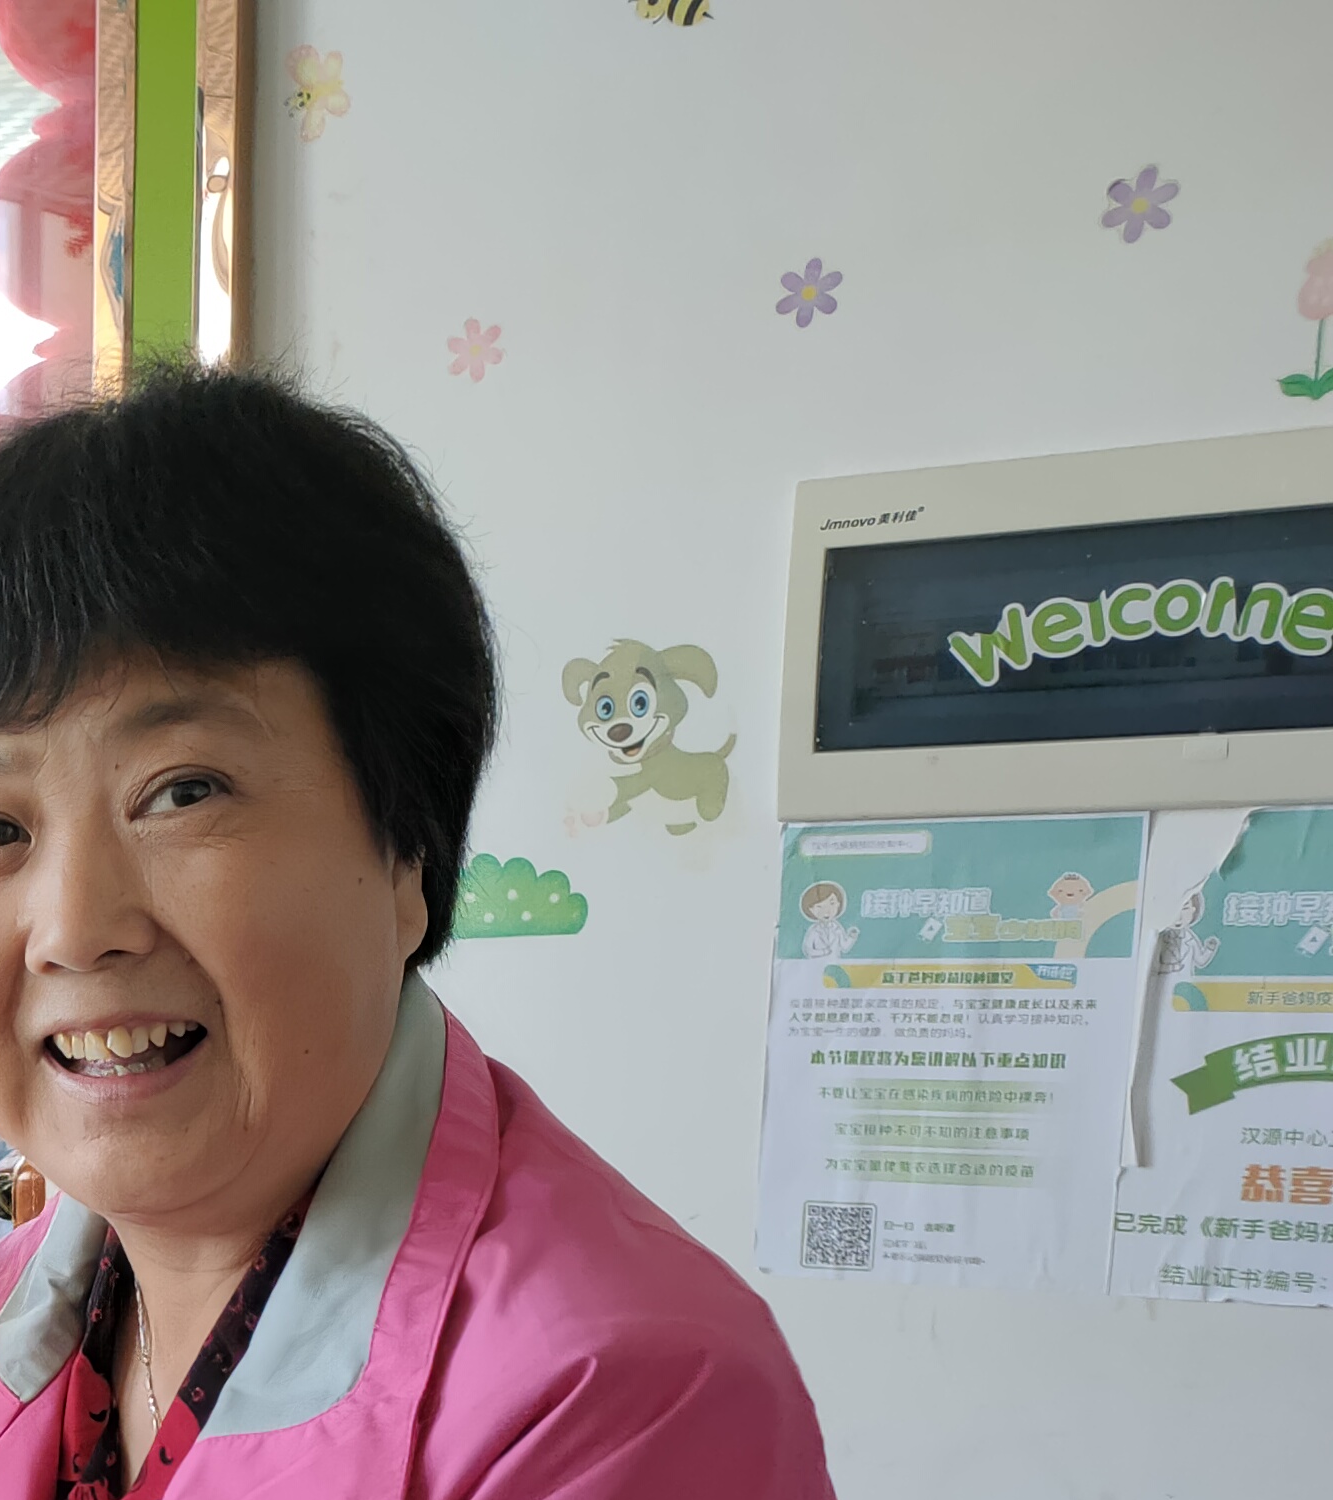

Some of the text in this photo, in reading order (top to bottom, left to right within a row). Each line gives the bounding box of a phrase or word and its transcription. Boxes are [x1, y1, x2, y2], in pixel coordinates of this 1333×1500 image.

[1234, 1037, 1333, 1081] 结业
[1240, 1127, 1333, 1148] 汉源中心
[1241, 1164, 1333, 1205] 恭喜
